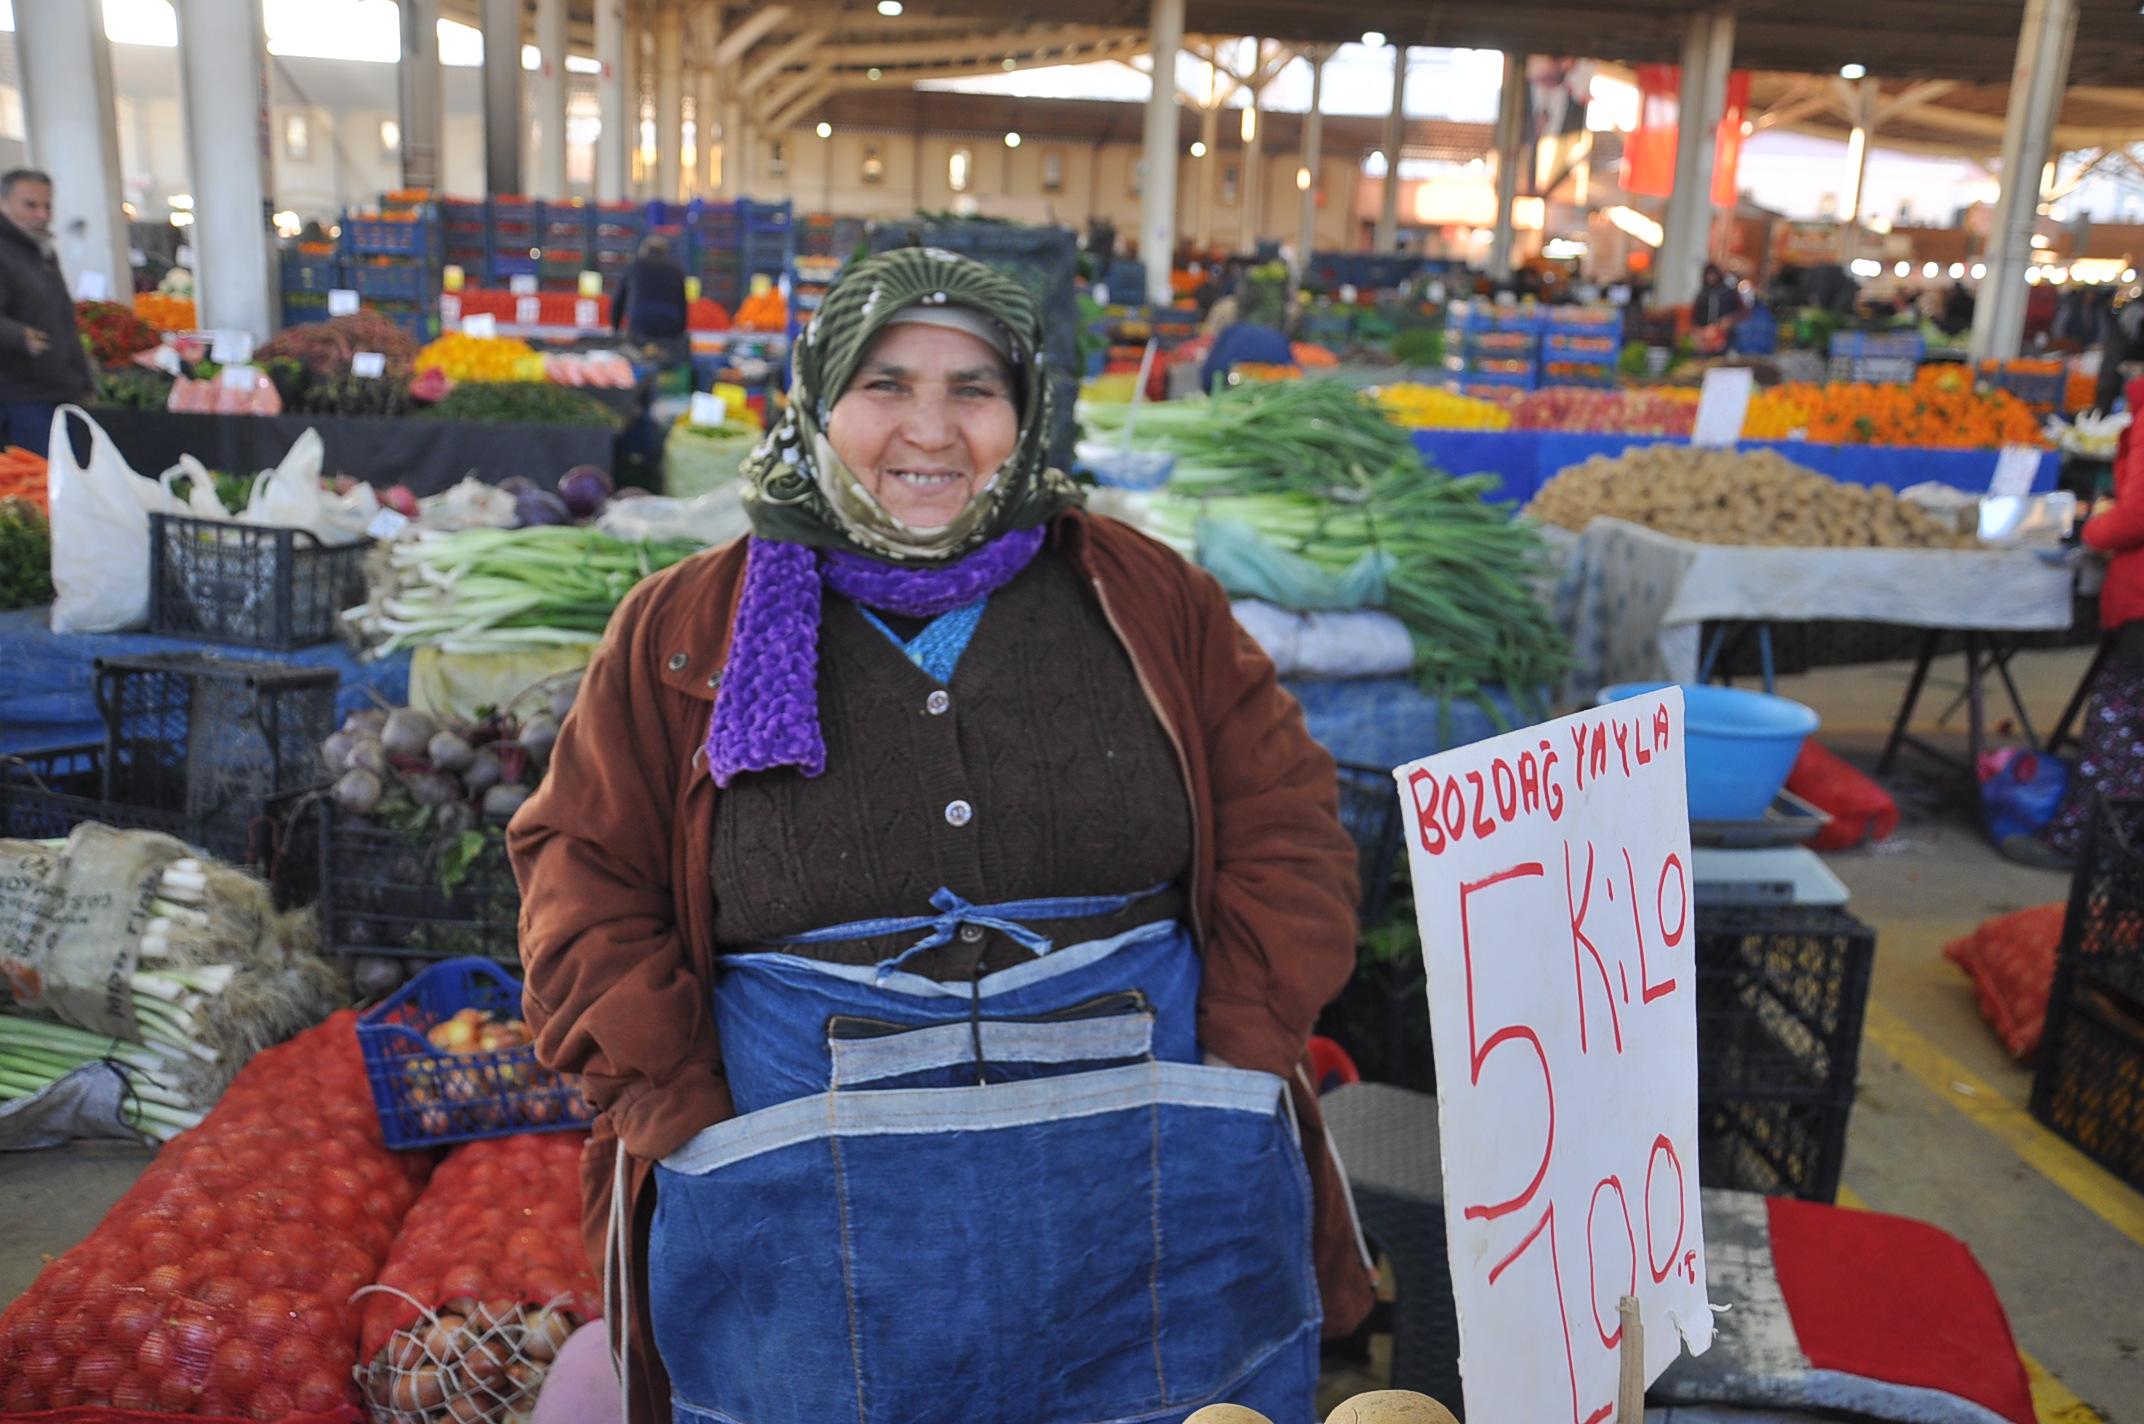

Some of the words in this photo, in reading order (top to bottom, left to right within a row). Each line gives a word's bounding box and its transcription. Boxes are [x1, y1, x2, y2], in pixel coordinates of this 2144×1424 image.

[1409, 740, 1564, 855] BOZDAĞ
[1571, 703, 1669, 791] YAYLA
[1460, 862, 1555, 1221] 5
